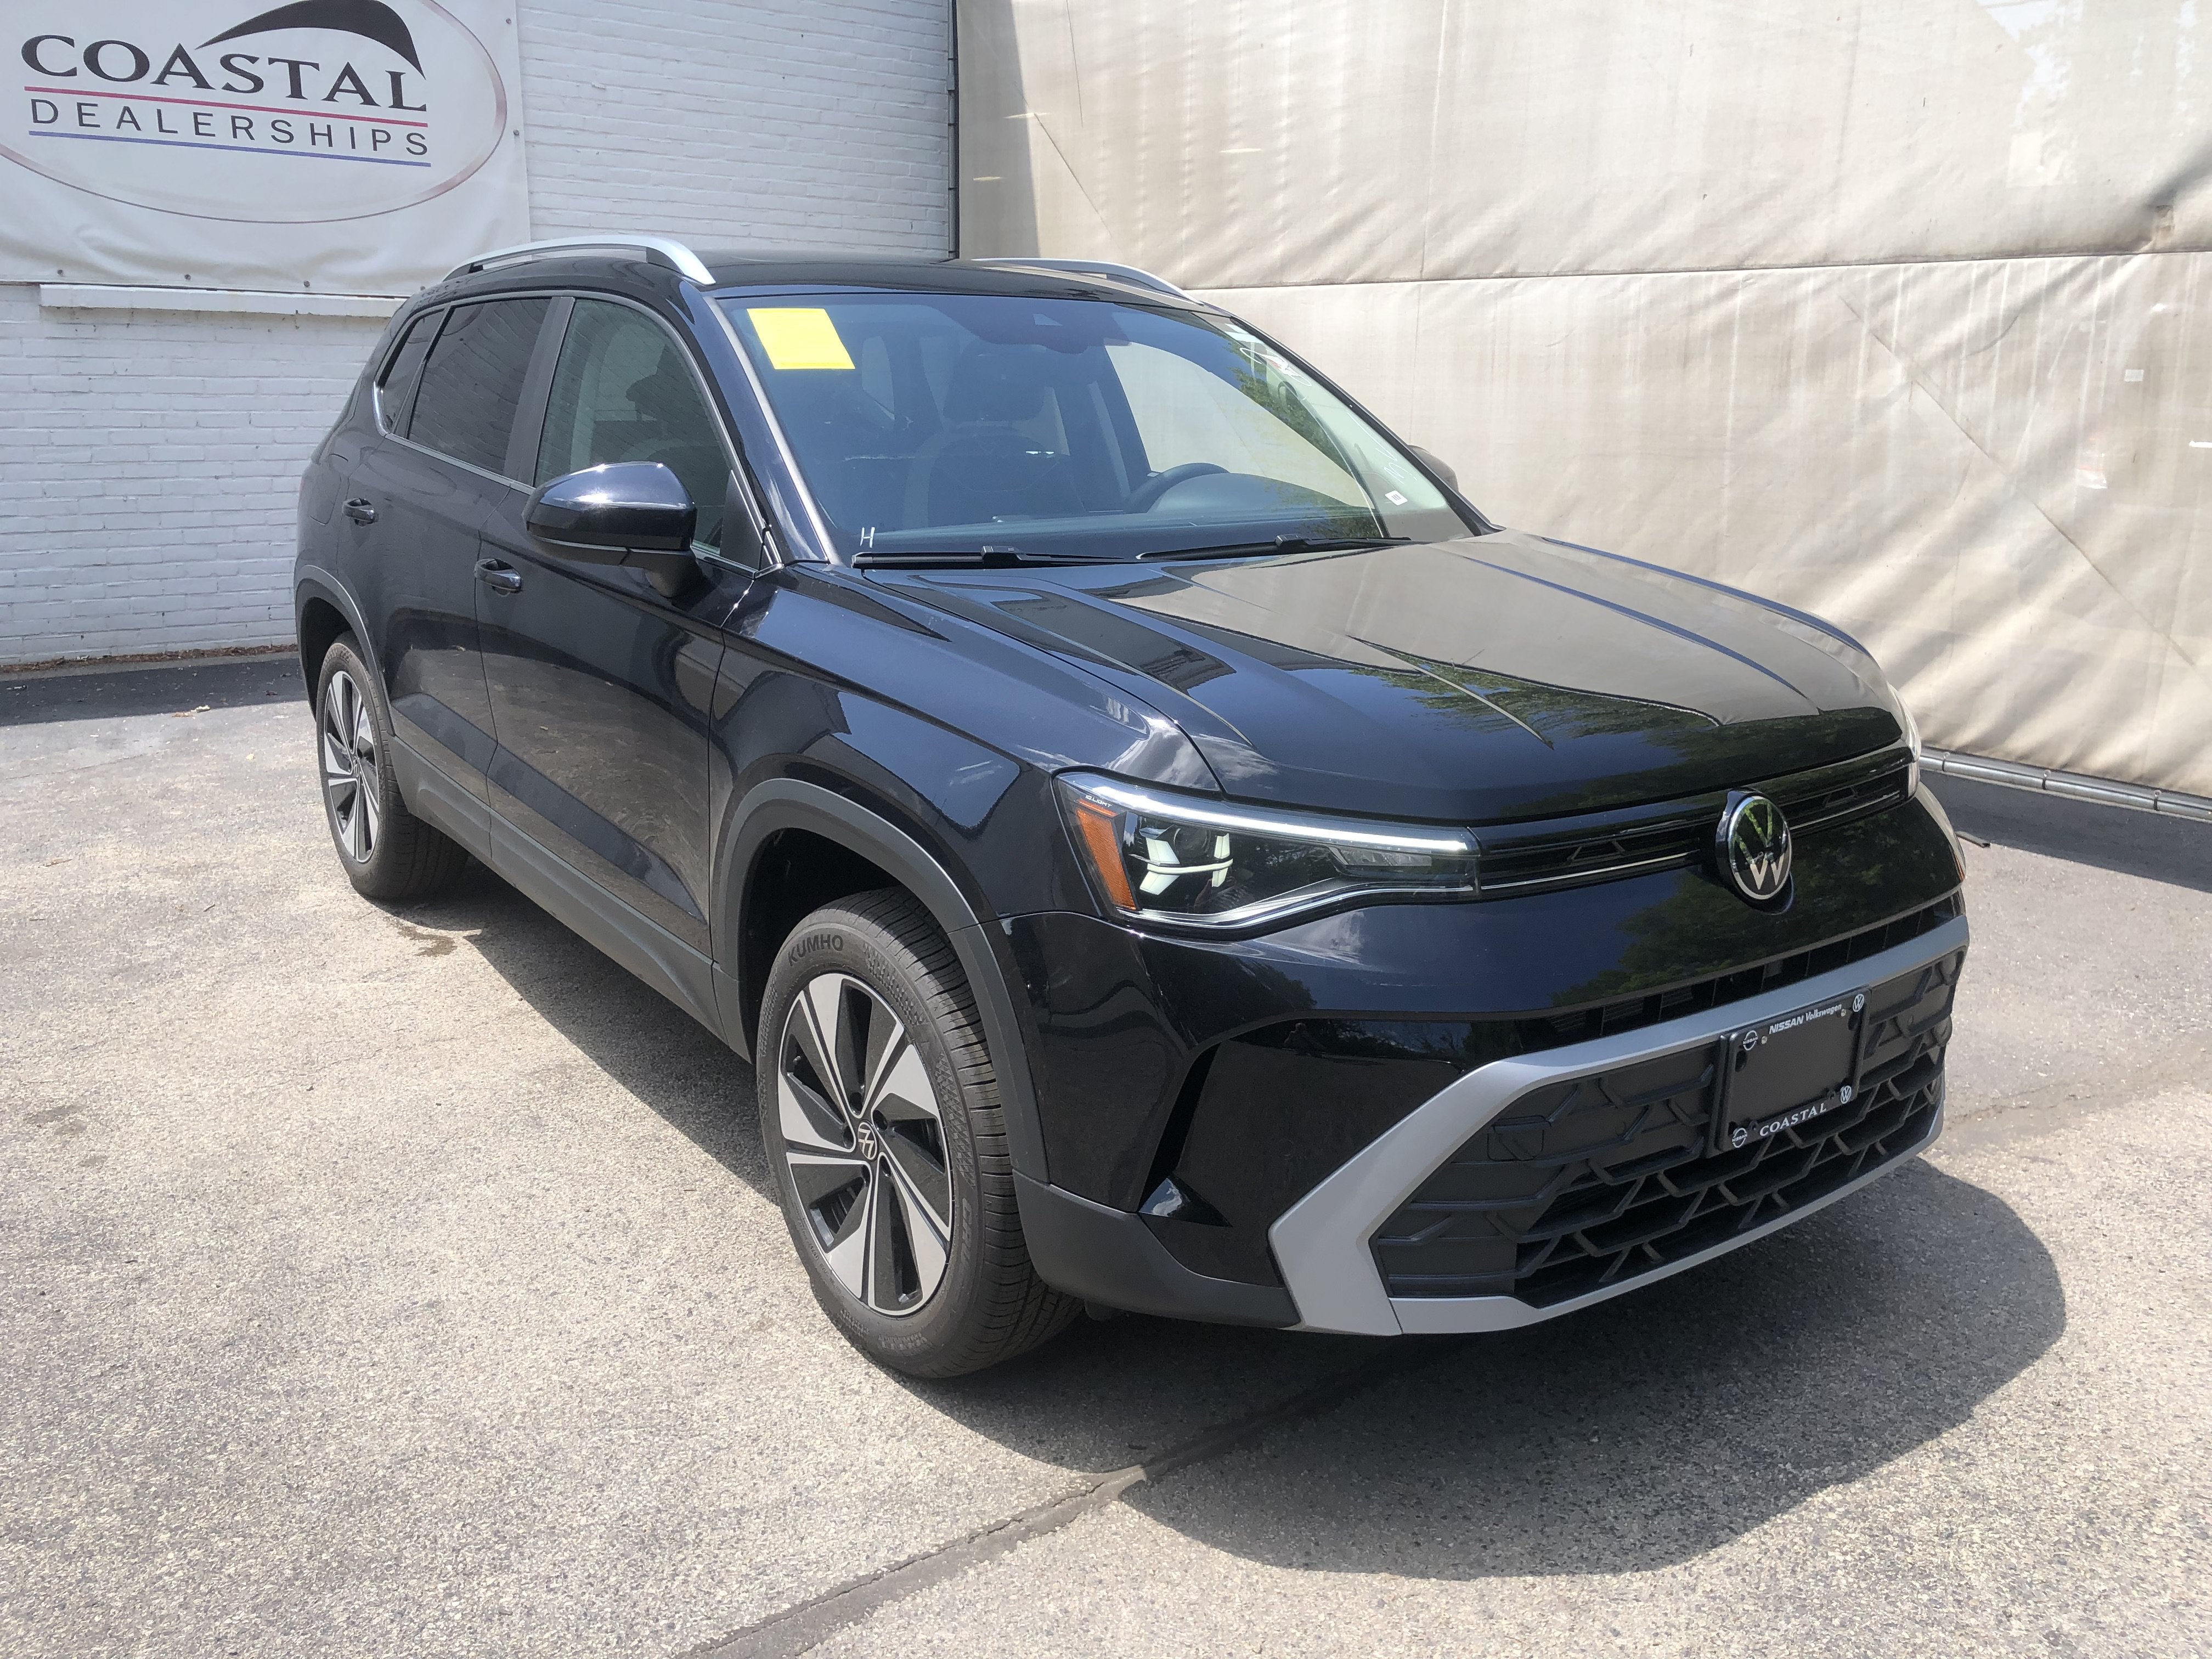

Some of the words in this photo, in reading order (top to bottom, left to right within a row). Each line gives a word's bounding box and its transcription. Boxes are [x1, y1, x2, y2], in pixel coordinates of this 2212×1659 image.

[21, 35, 427, 112] COASTAL
[32, 99, 428, 155] DEALERSHIPS
[788, 934, 843, 967] KUMHO
[1769, 1015, 1804, 1034] NISSAN
[1805, 1003, 1842, 1022] Volkswagen
[1759, 1103, 1826, 1137] COASTAL
